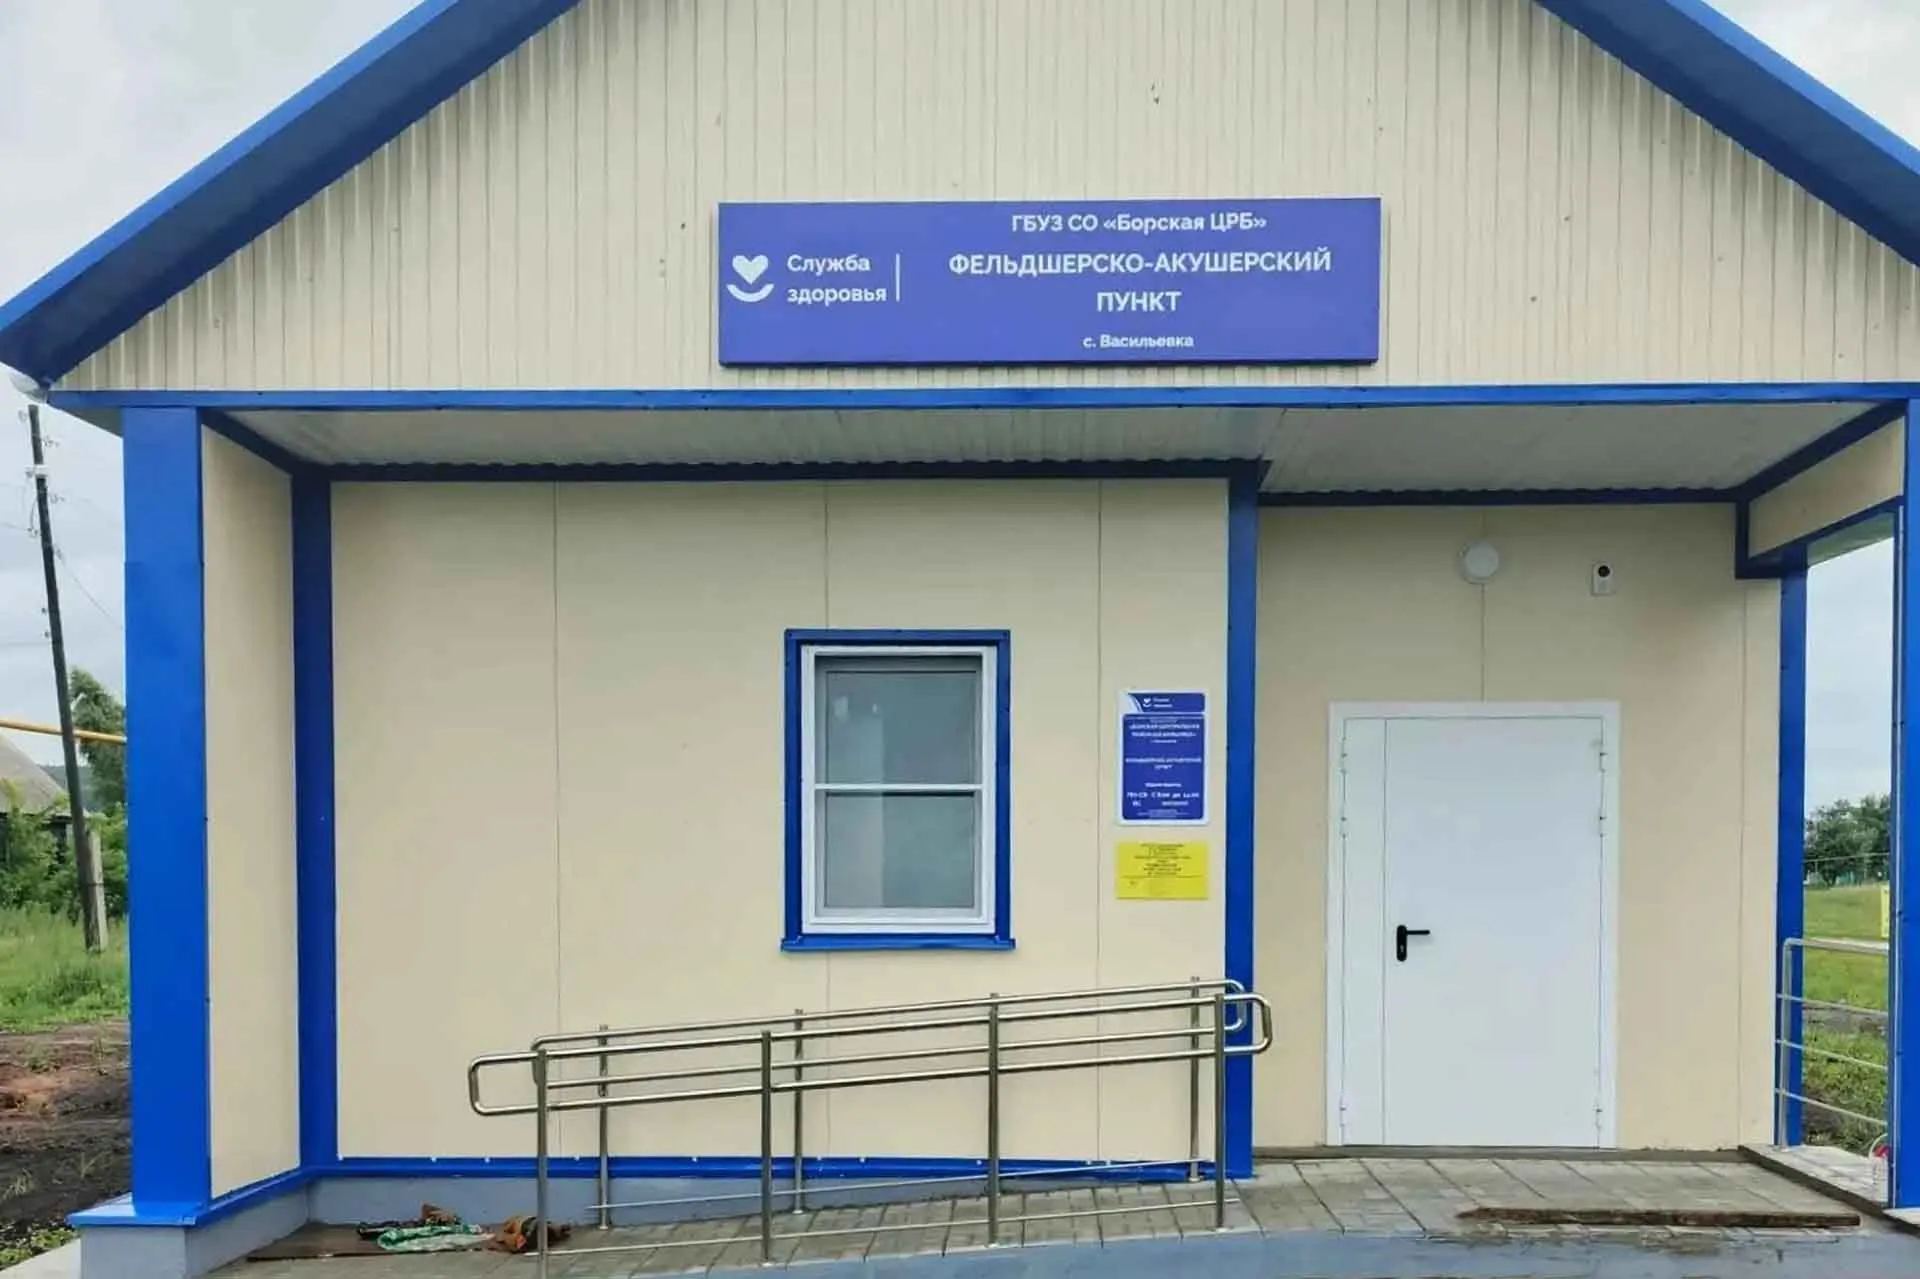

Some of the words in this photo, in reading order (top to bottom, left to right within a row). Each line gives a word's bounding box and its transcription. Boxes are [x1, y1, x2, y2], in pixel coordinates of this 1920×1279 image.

[1012, 215, 1063, 233] ГБУЗ
[1067, 214, 1098, 232] СО
[1103, 214, 1206, 236] «Борская
[1210, 213, 1268, 234] ЦРБ»
[787, 254, 871, 277] Служба
[949, 247, 1332, 278] ФЕЛЬДШЕРСКО-АКУШЕРСКИЙ
[787, 287, 887, 306] здоровья
[1097, 291, 1182, 313] ПУНКТ
[1082, 337, 1096, 349] с.
[1100, 334, 1194, 349] Васильевка
